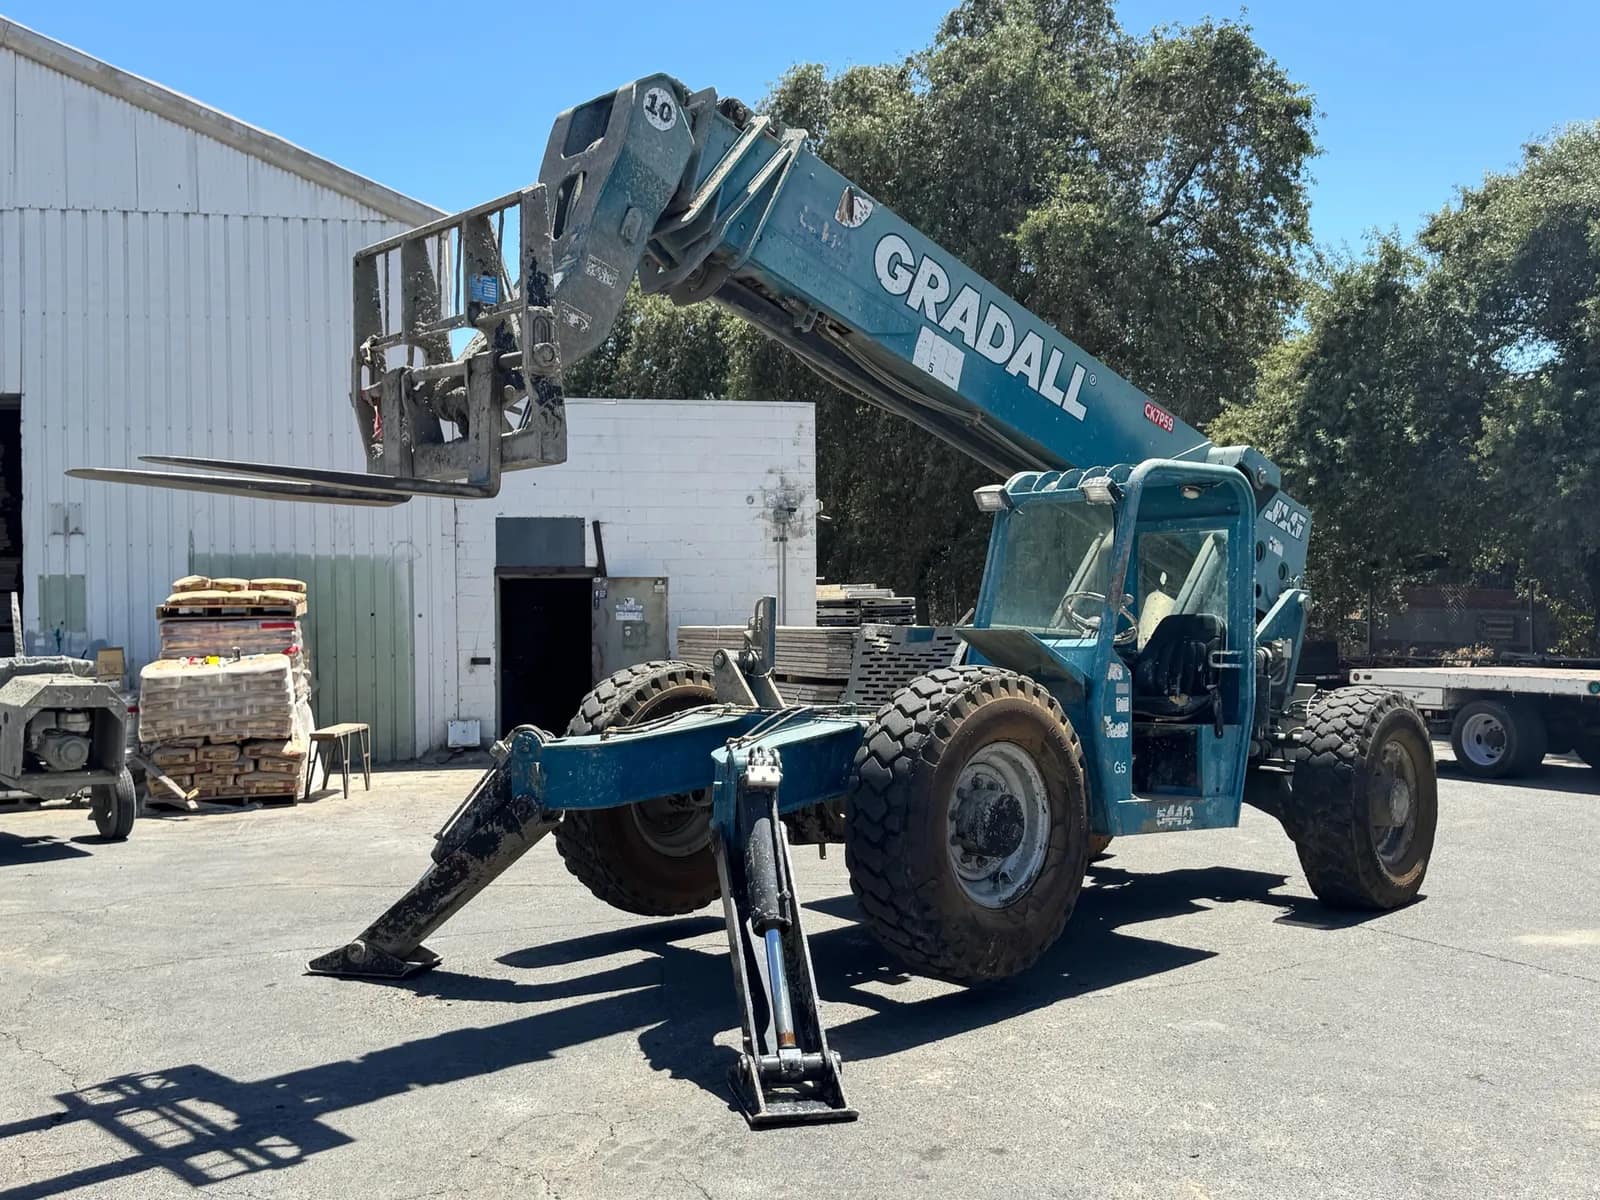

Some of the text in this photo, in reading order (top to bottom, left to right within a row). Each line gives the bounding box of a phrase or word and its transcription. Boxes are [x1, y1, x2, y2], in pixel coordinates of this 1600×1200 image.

[645, 93, 673, 123] 10
[873, 232, 1088, 422] GRADALL
[927, 362, 935, 374] 5
[1144, 402, 1174, 433] CK7P59
